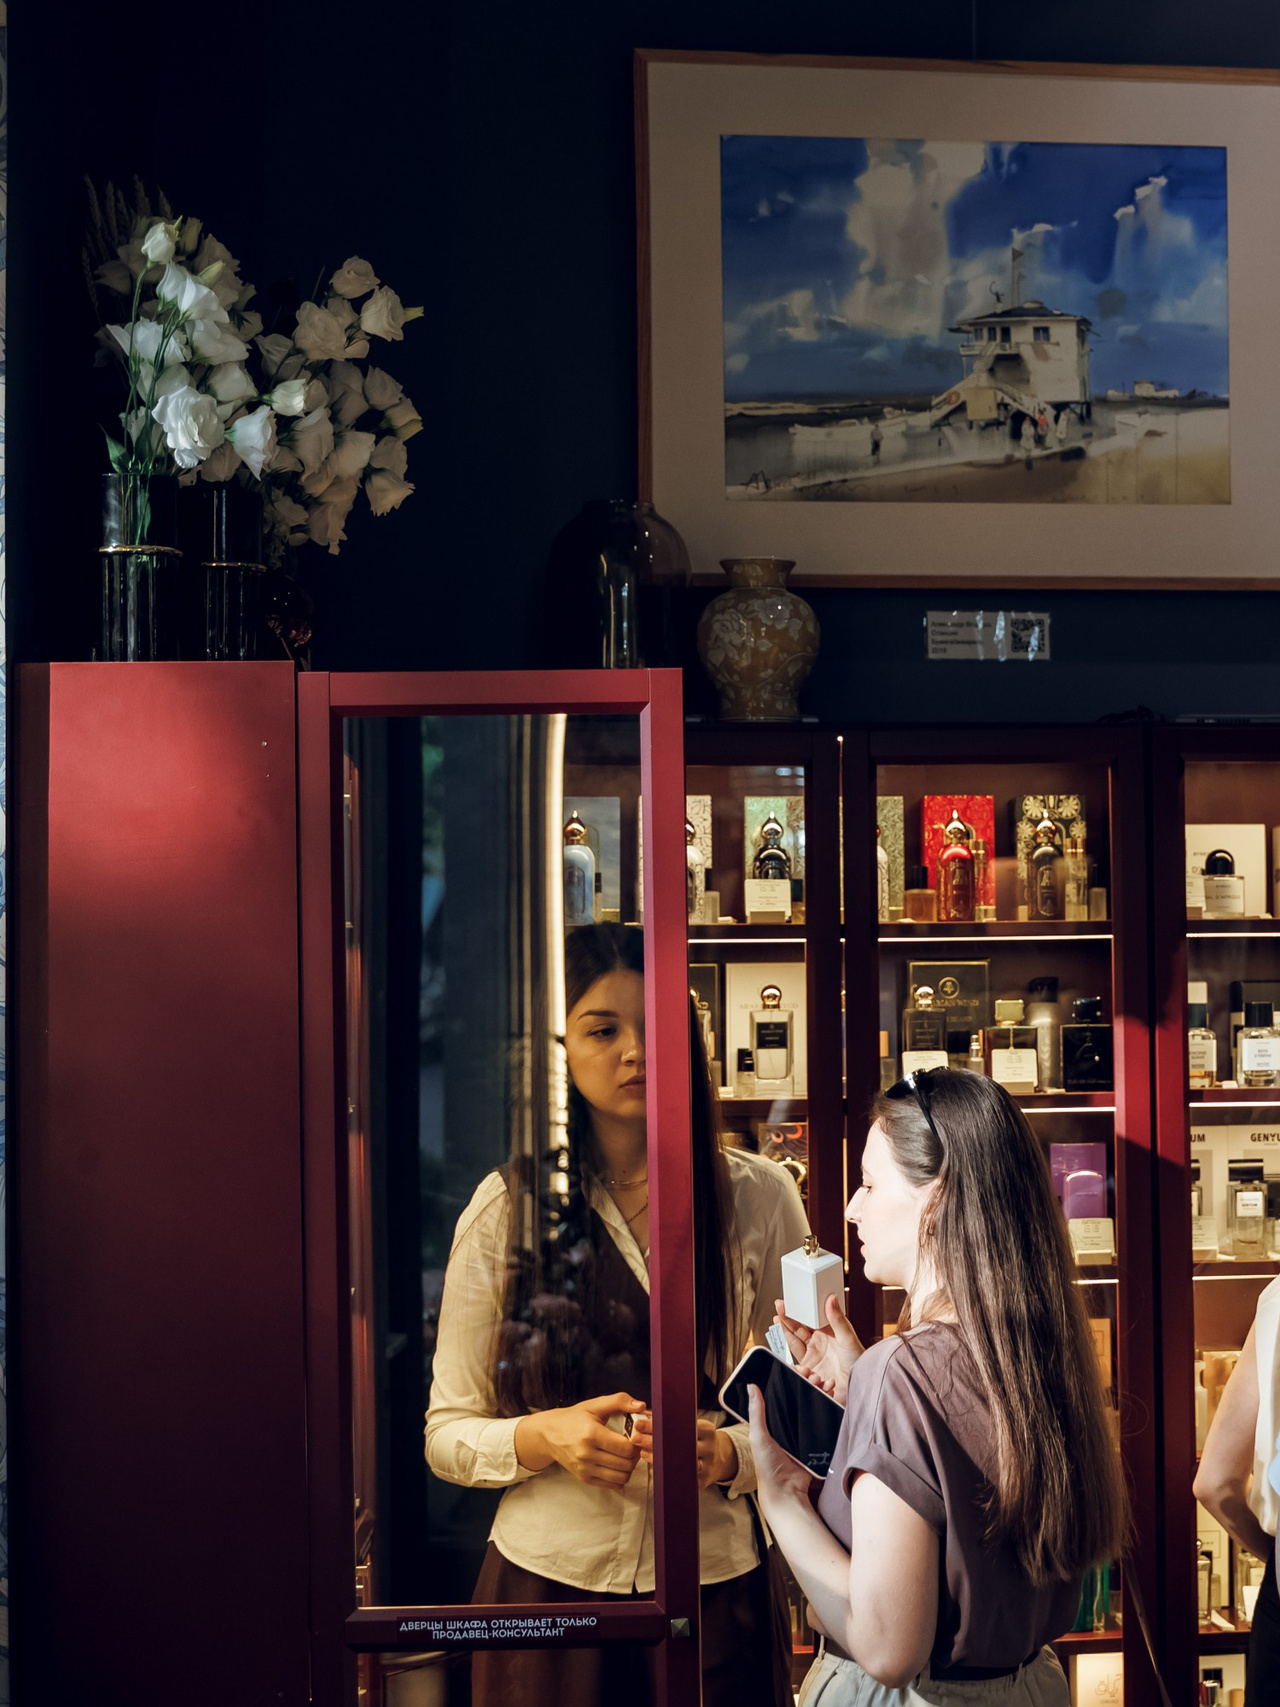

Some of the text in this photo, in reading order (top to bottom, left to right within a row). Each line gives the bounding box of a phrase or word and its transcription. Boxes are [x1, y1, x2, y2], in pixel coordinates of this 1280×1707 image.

[399, 1617, 597, 1632] ДВЕРЦЫ ШКАФА ОТКРЫВАЕТ ТОЛЬКО
[432, 1627, 565, 1640] ПРОДАВЕЦ-КОНСУЛЬТАНТ
